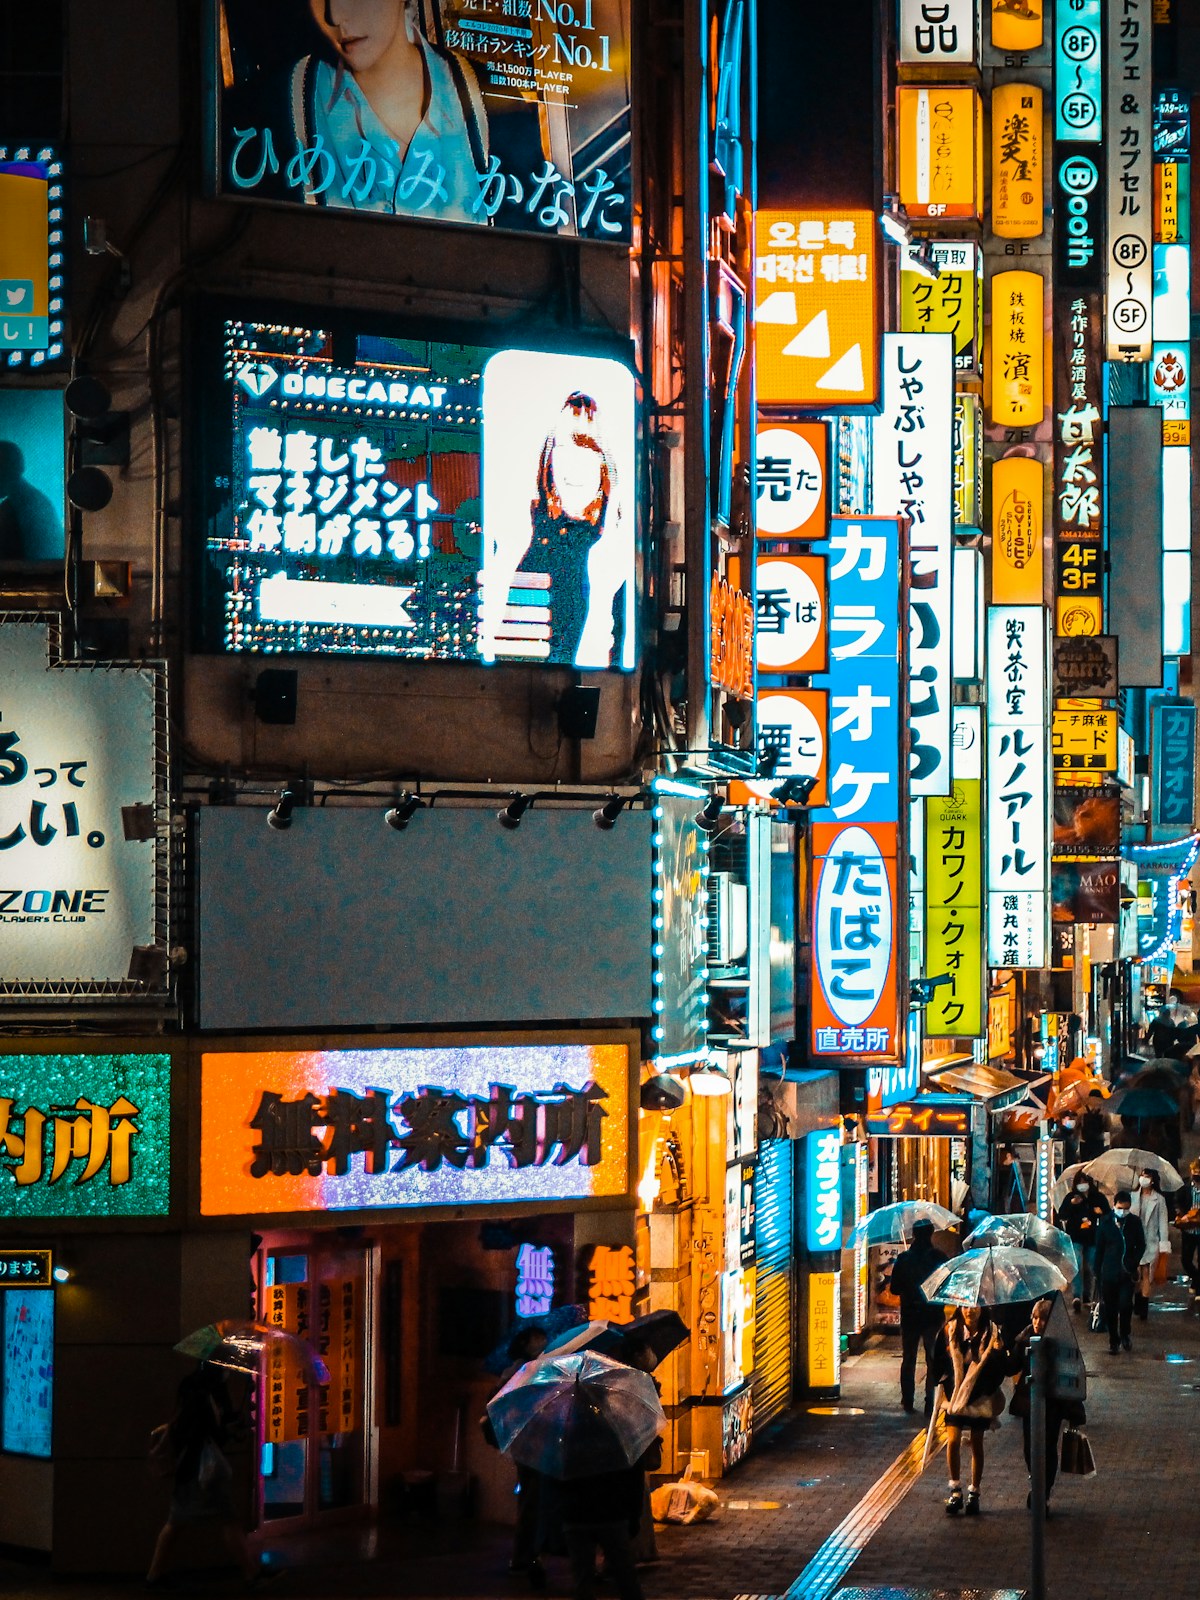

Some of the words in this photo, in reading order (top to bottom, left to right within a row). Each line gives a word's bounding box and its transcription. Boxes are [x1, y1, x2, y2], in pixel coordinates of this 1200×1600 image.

[445, 30, 551, 60] 移籍者ランキング
[552, 33, 612, 72] No.1
[1069, 36, 1090, 52] 8F
[534, 69, 573, 82] PLAYER
[1069, 103, 1091, 118] 5F
[1120, 95, 1139, 114] &
[230, 126, 450, 211] ひめがみ
[471, 155, 625, 235] かなた
[1118, 126, 1141, 216] カプセル
[927, 204, 947, 217] 6F
[1060, 157, 1097, 269] Booth
[1004, 244, 1031, 256] 6F
[1118, 243, 1141, 261] 8F
[1119, 308, 1141, 325] 5F
[955, 355, 974, 369] 5F
[1070, 298, 1089, 400] 手作り居酒屋
[282, 373, 447, 408] ONECARAT
[893, 345, 927, 525] しゃぶしゃぶ
[796, 469, 819, 492] た
[1057, 403, 1100, 528] 甘太郎
[248, 474, 439, 520] マネジメント
[1062, 544, 1097, 567] 4F
[1062, 568, 1097, 590] 3F
[795, 601, 818, 624] ば
[828, 525, 891, 820] カラオケ
[1165, 711, 1190, 819] カラオケ
[939, 813, 968, 821] QUARK
[999, 728, 1037, 876] ルノアール
[1080, 874, 1117, 887] MAO
[1139, 861, 1180, 869] KARAOKE
[829, 850, 884, 1001] たばこ
[941, 826, 966, 1026] カワノ・クォーク
[1002, 895, 1019, 966] 磯丸水産
[815, 1026, 889, 1053] 直売所
[250, 1082, 611, 1179] 無料案内所
[815, 1133, 841, 1247] カラオケ
[813, 1300, 828, 1371] 品种齐全
